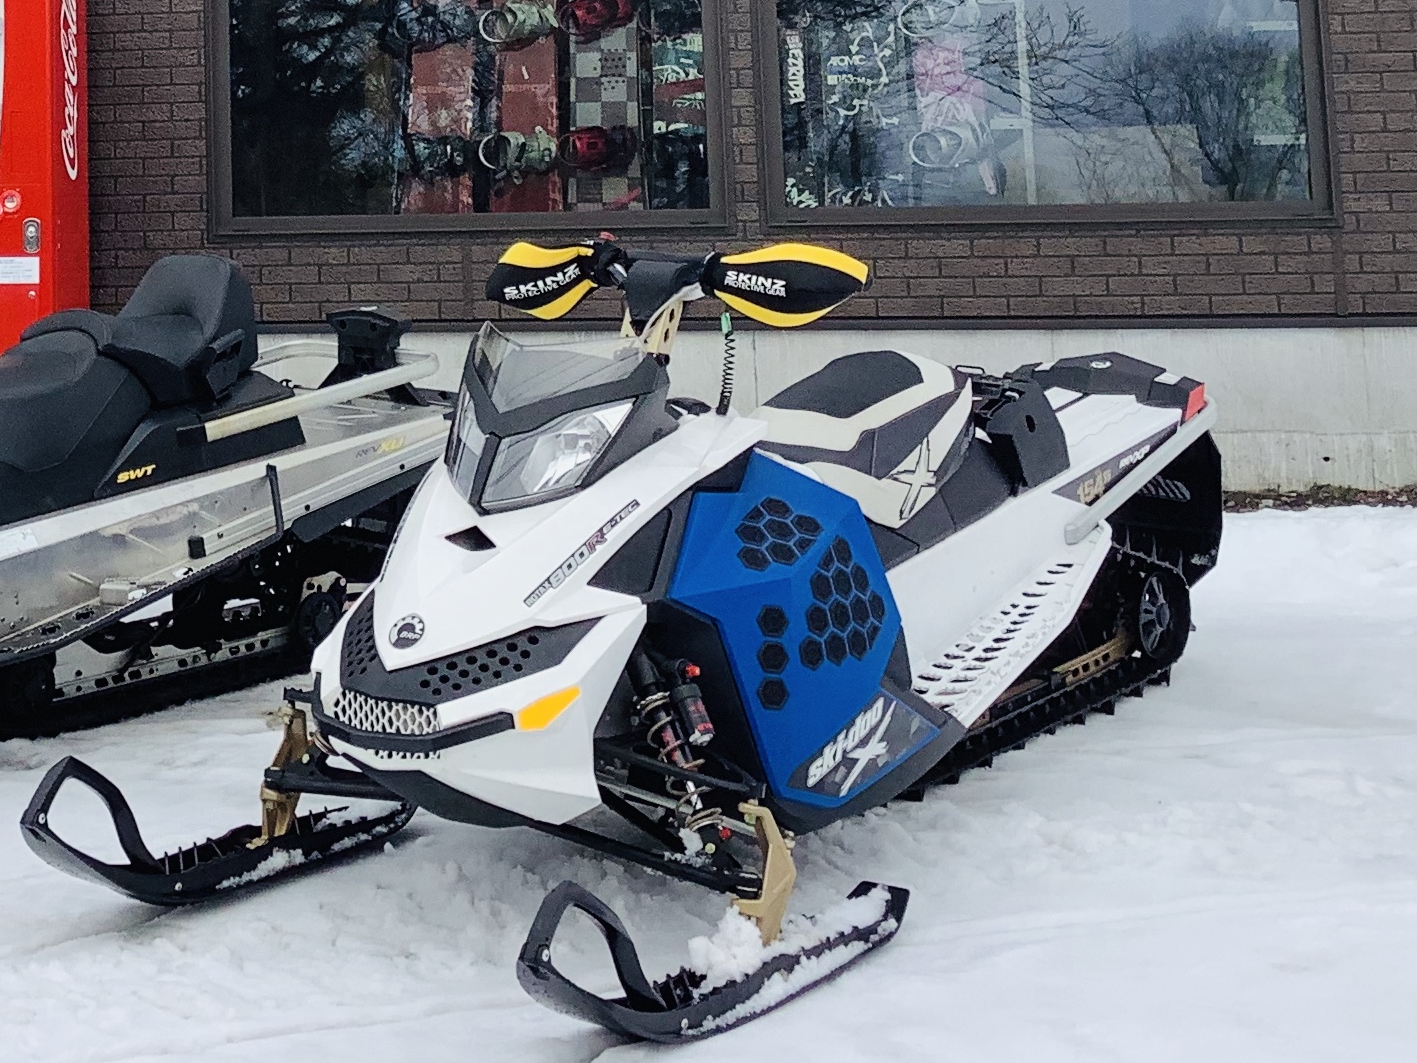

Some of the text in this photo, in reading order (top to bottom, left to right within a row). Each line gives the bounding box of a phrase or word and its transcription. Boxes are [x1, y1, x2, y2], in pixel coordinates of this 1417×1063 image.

[503, 263, 578, 294] SKINZ
[726, 270, 787, 289] SKINZ
[116, 464, 157, 484] SWT
[524, 581, 552, 607] ROTAX
[807, 697, 884, 788] ski-doo
